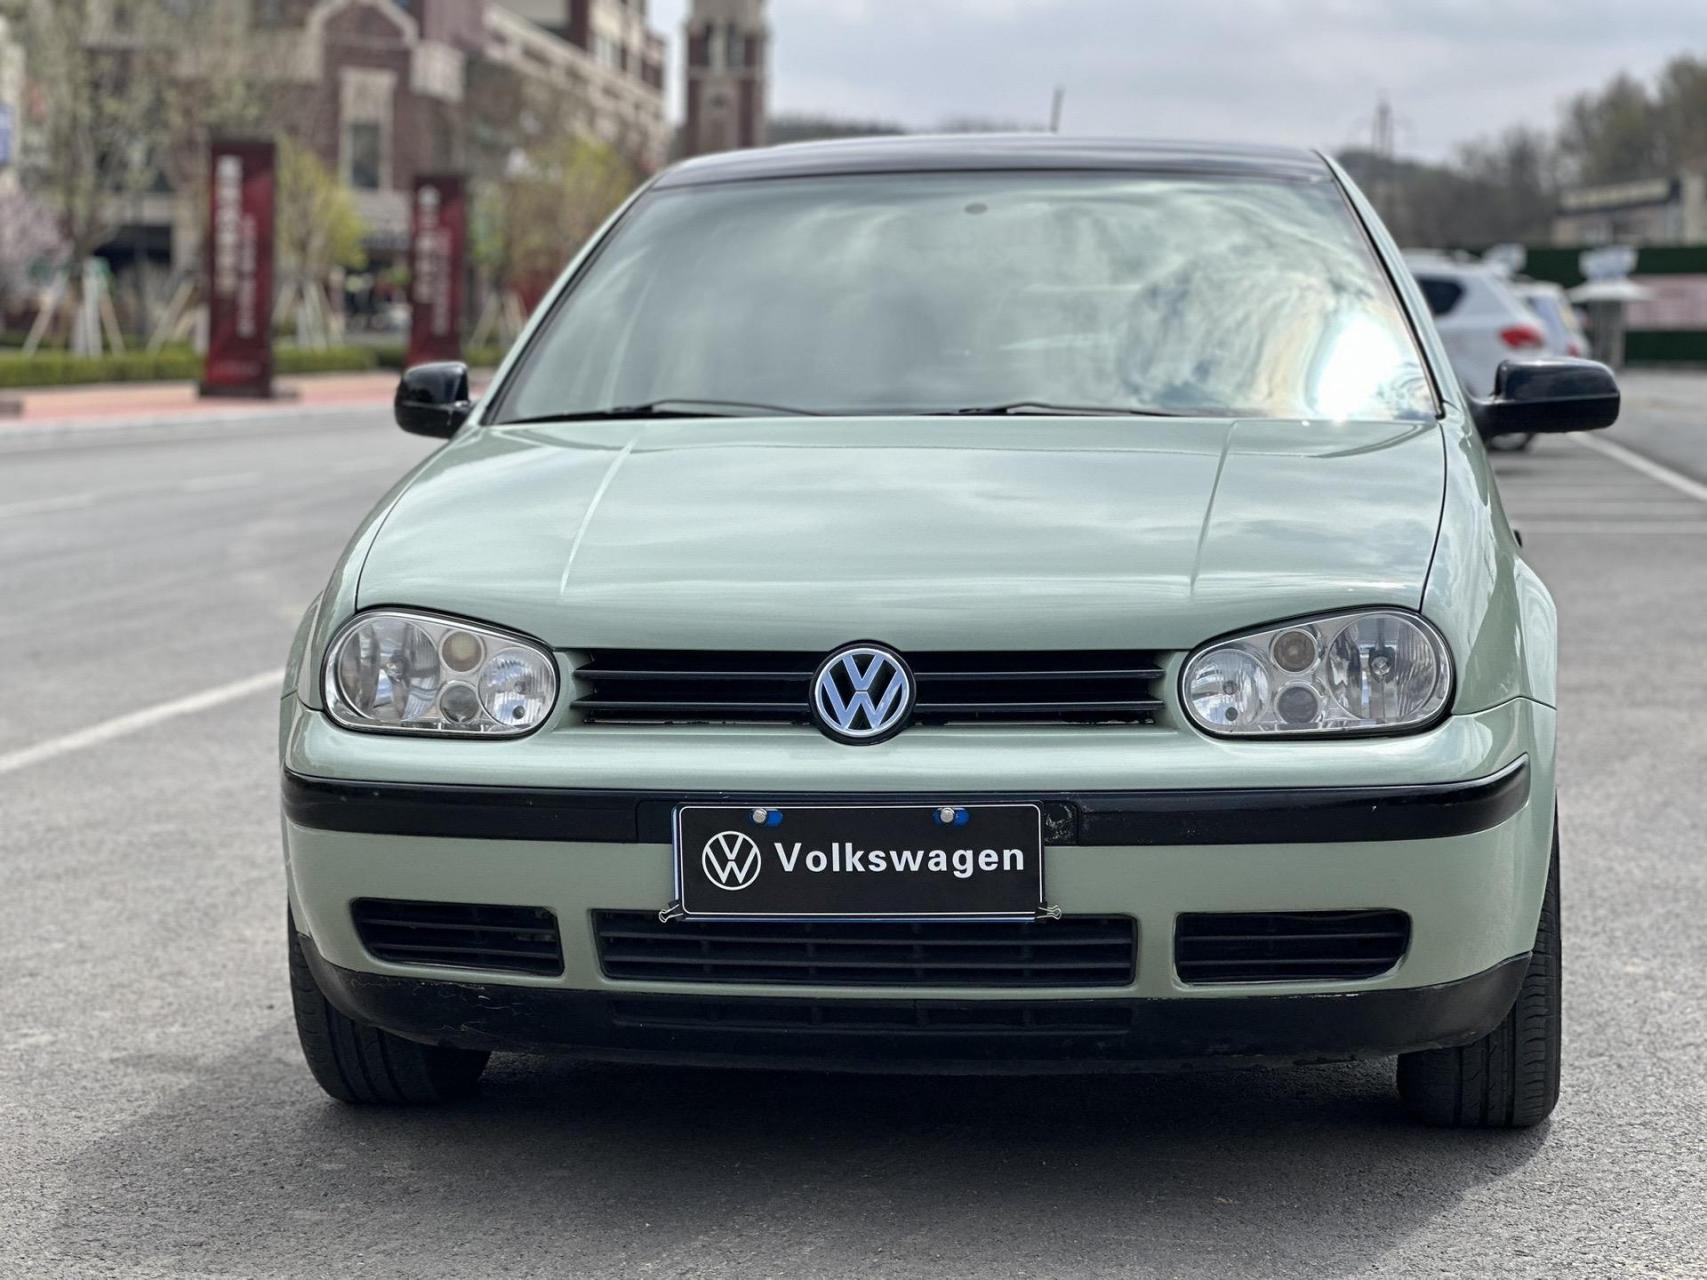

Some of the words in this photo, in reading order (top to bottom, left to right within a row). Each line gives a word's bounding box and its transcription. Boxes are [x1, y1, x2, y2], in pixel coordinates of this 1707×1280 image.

[818, 650, 906, 732] VW
[703, 832, 760, 887] VW
[773, 841, 1025, 879] Volkswagen
